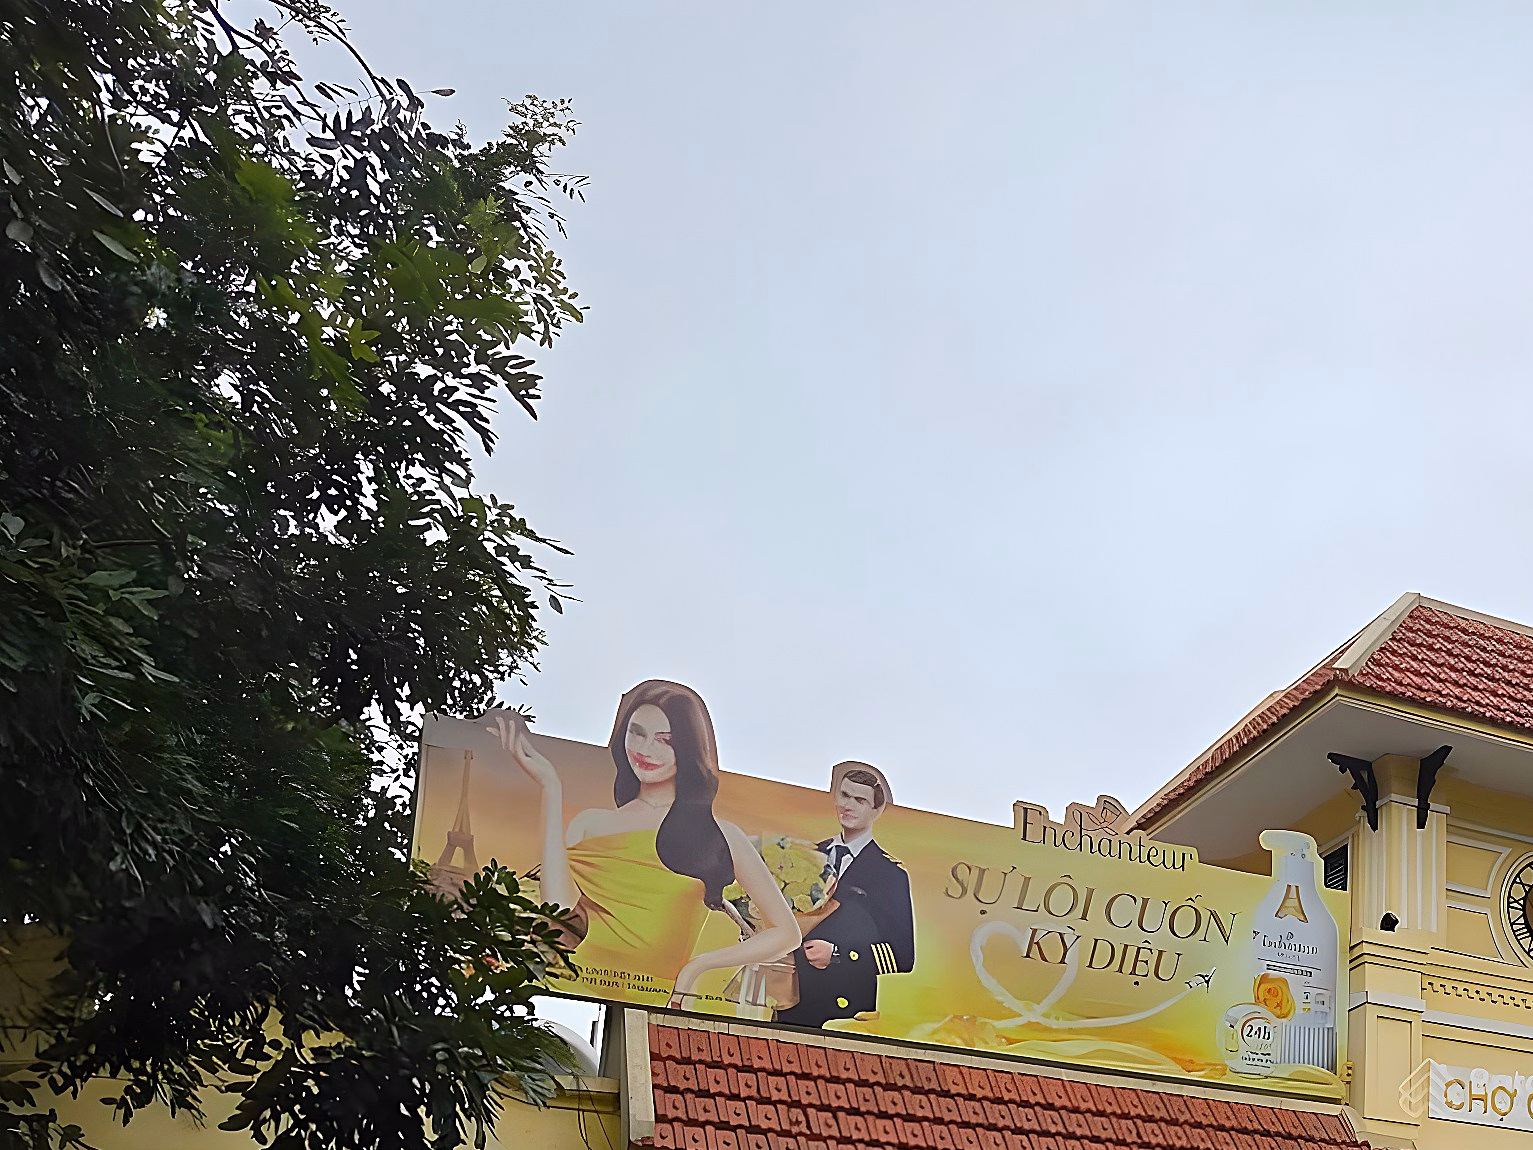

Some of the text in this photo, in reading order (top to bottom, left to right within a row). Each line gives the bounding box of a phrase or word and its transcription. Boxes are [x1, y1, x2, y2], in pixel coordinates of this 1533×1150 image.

[1020, 806, 1194, 872] Enchanteur
[1013, 875, 1096, 922] LÔI
[1104, 893, 1242, 946] CUỐN
[1086, 941, 1183, 987] DIỆU
[1443, 1078, 1518, 1121] CHỢ
